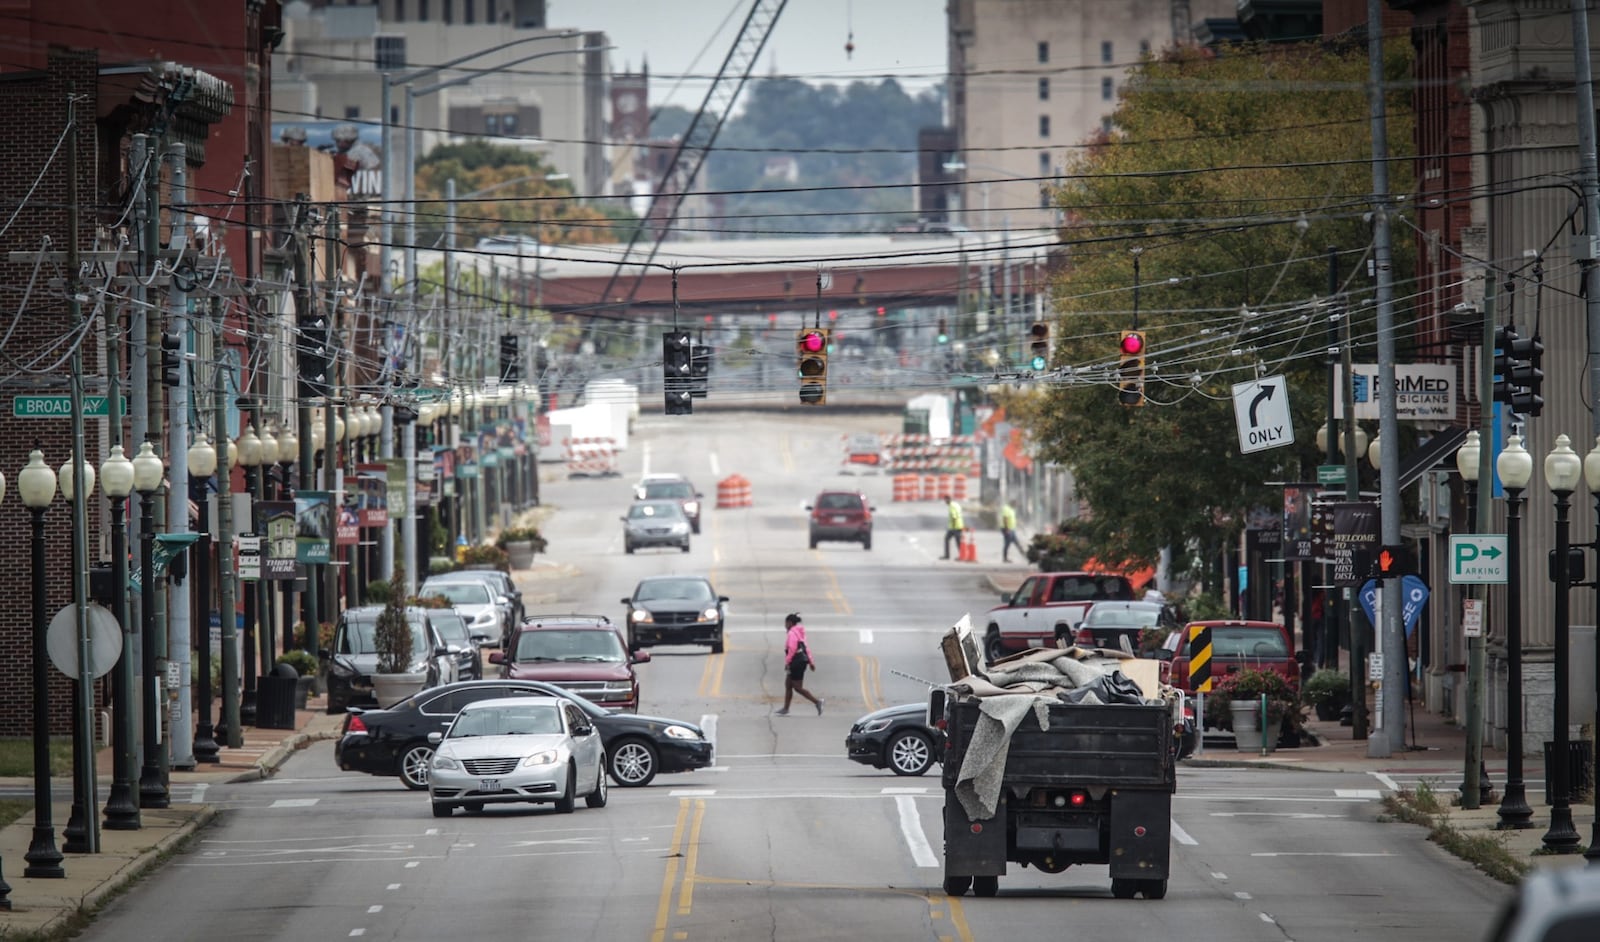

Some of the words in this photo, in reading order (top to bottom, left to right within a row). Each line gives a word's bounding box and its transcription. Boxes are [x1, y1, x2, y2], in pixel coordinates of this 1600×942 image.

[27, 400, 101, 413] BROADAY
[1249, 426, 1283, 445] ONLY
[1334, 534, 1376, 542] WELCOME
[1297, 541, 1312, 549] STA
[1335, 541, 1347, 549] TO
[1335, 557, 1353, 565] DUN
[1334, 564, 1354, 572] HIST
